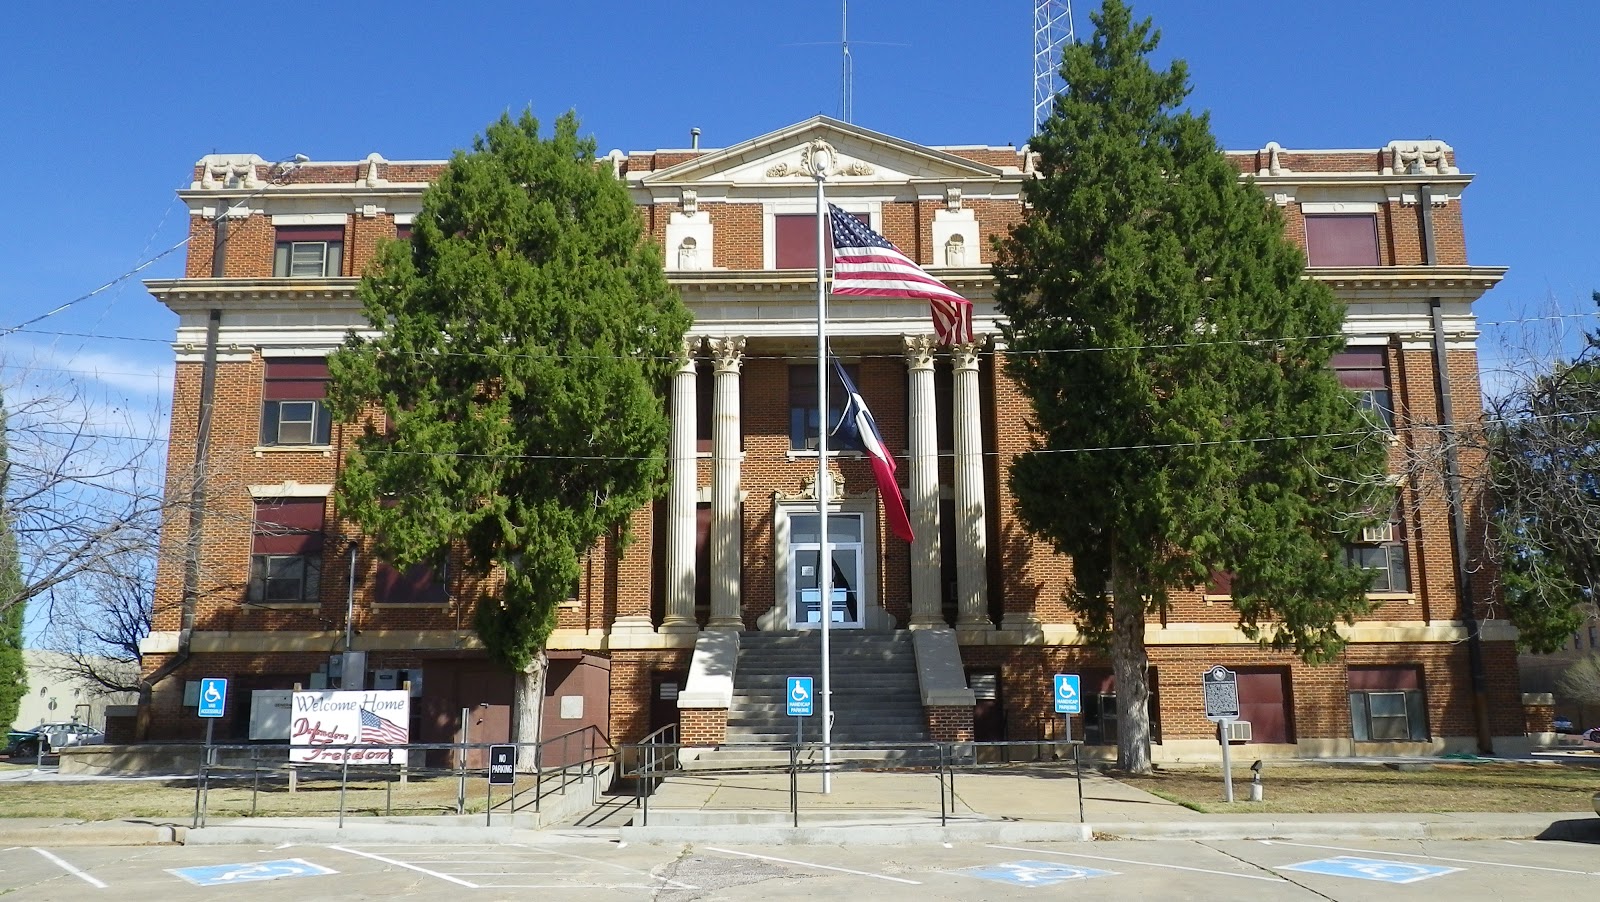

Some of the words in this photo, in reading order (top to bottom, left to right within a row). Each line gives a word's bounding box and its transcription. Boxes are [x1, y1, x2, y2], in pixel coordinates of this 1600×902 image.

[296, 696, 357, 712] Welcome
[361, 693, 405, 712] Home
[293, 718, 349, 742] Defenders
[302, 739, 394, 761] Freedom
[498, 754, 507, 763] NO
[491, 764, 513, 774] PARKING
